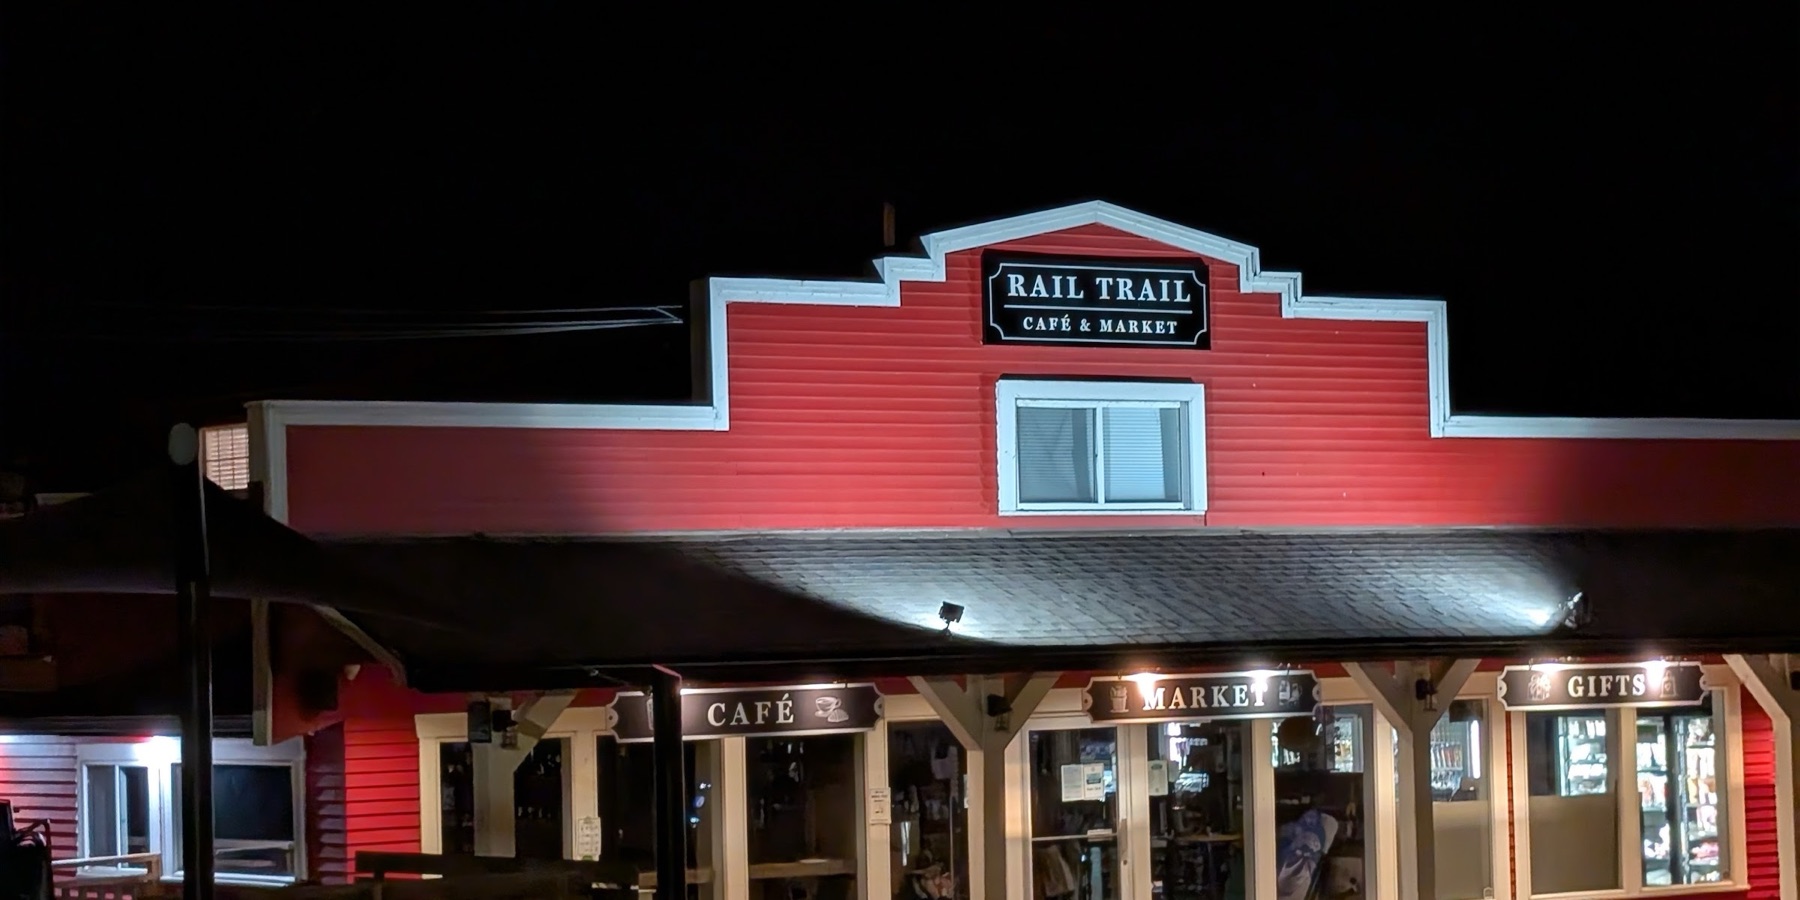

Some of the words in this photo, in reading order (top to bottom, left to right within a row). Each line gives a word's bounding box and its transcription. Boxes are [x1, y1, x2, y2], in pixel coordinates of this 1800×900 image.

[1007, 273, 1084, 299] RAIL
[1096, 277, 1191, 302] TRAIL
[1023, 314, 1072, 332] CAFÉ
[1079, 318, 1091, 332] &
[1100, 319, 1178, 334] MARKET
[1142, 681, 1269, 711] MARKET
[1567, 673, 1646, 698] GIFTS
[707, 692, 794, 727] CAFÉ
